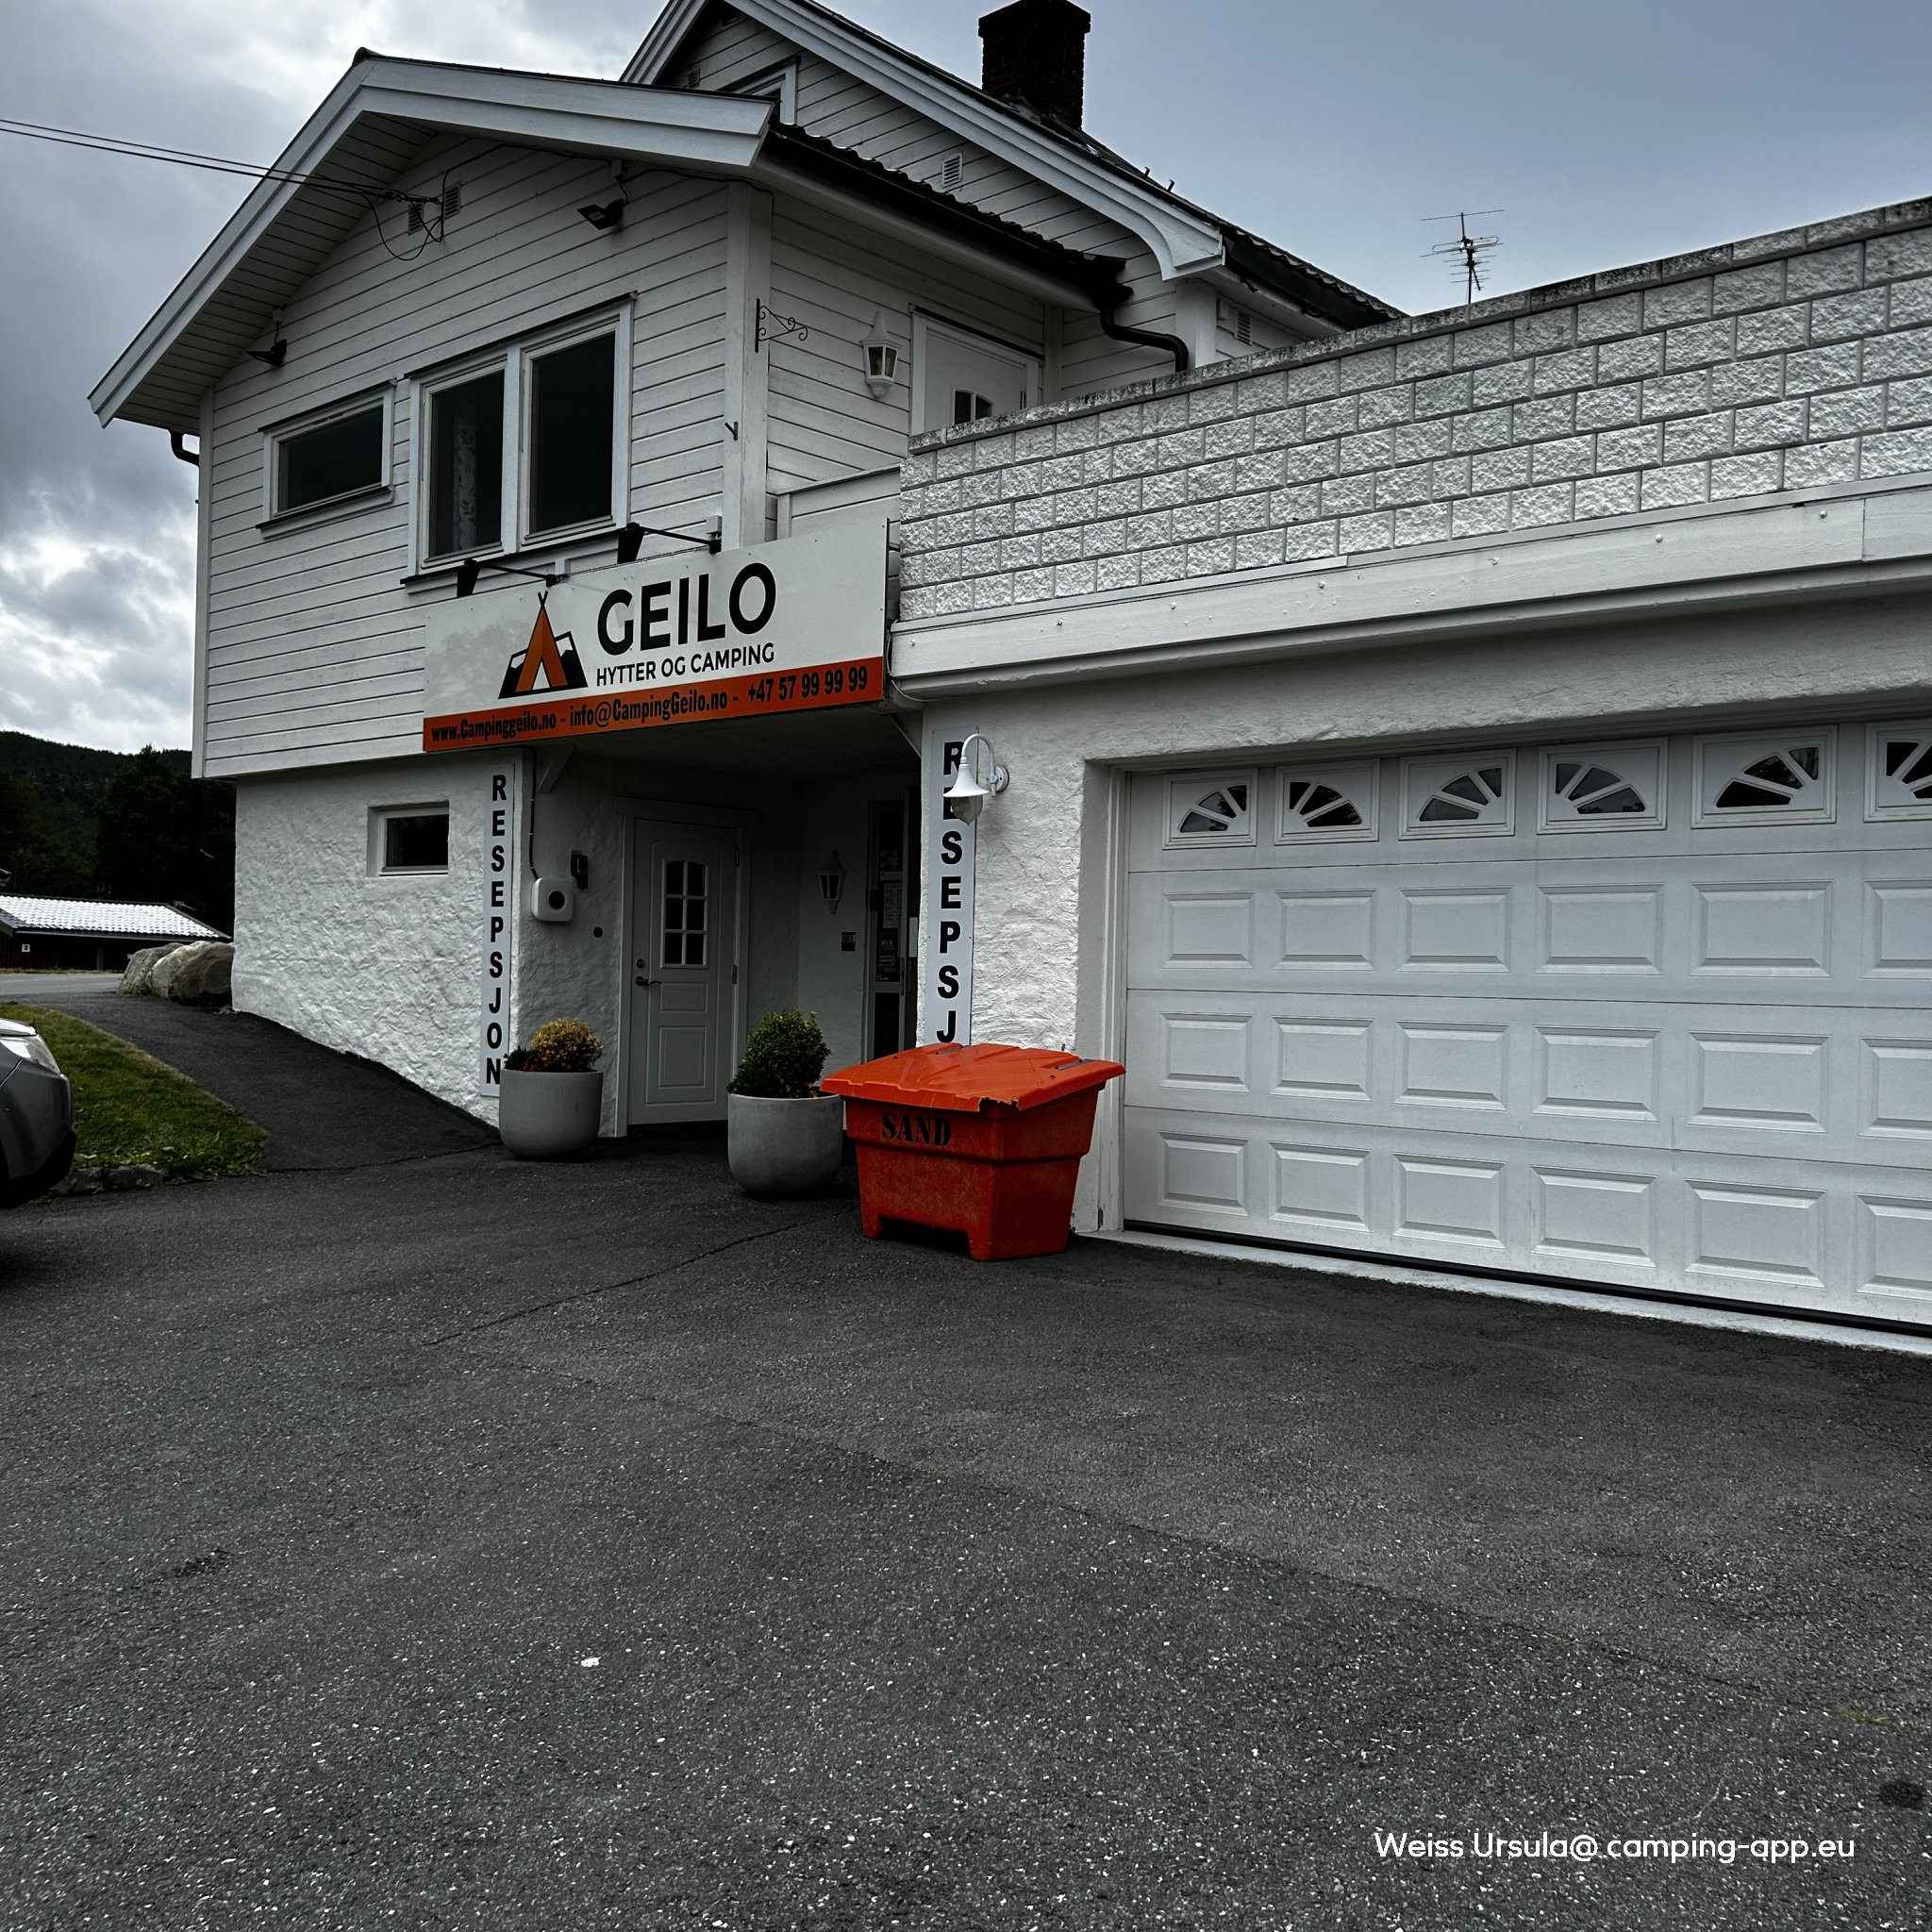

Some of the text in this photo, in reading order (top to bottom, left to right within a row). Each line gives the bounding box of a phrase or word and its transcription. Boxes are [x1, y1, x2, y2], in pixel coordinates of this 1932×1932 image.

[596, 562, 776, 656] GEILO
[596, 642, 774, 687] HYTTER OG CAMPING
[431, 710, 557, 741] www.Campinggeilo.no
[570, 690, 728, 727] info@CampingGeilo.no
[747, 678, 774, 703] +47
[778, 675, 797, 701] 57
[801, 672, 820, 698] 99
[824, 668, 843, 694] 99
[848, 665, 868, 691] 99
[486, 774, 507, 1085] RESEPSJON
[882, 1113, 952, 1146] SAND
